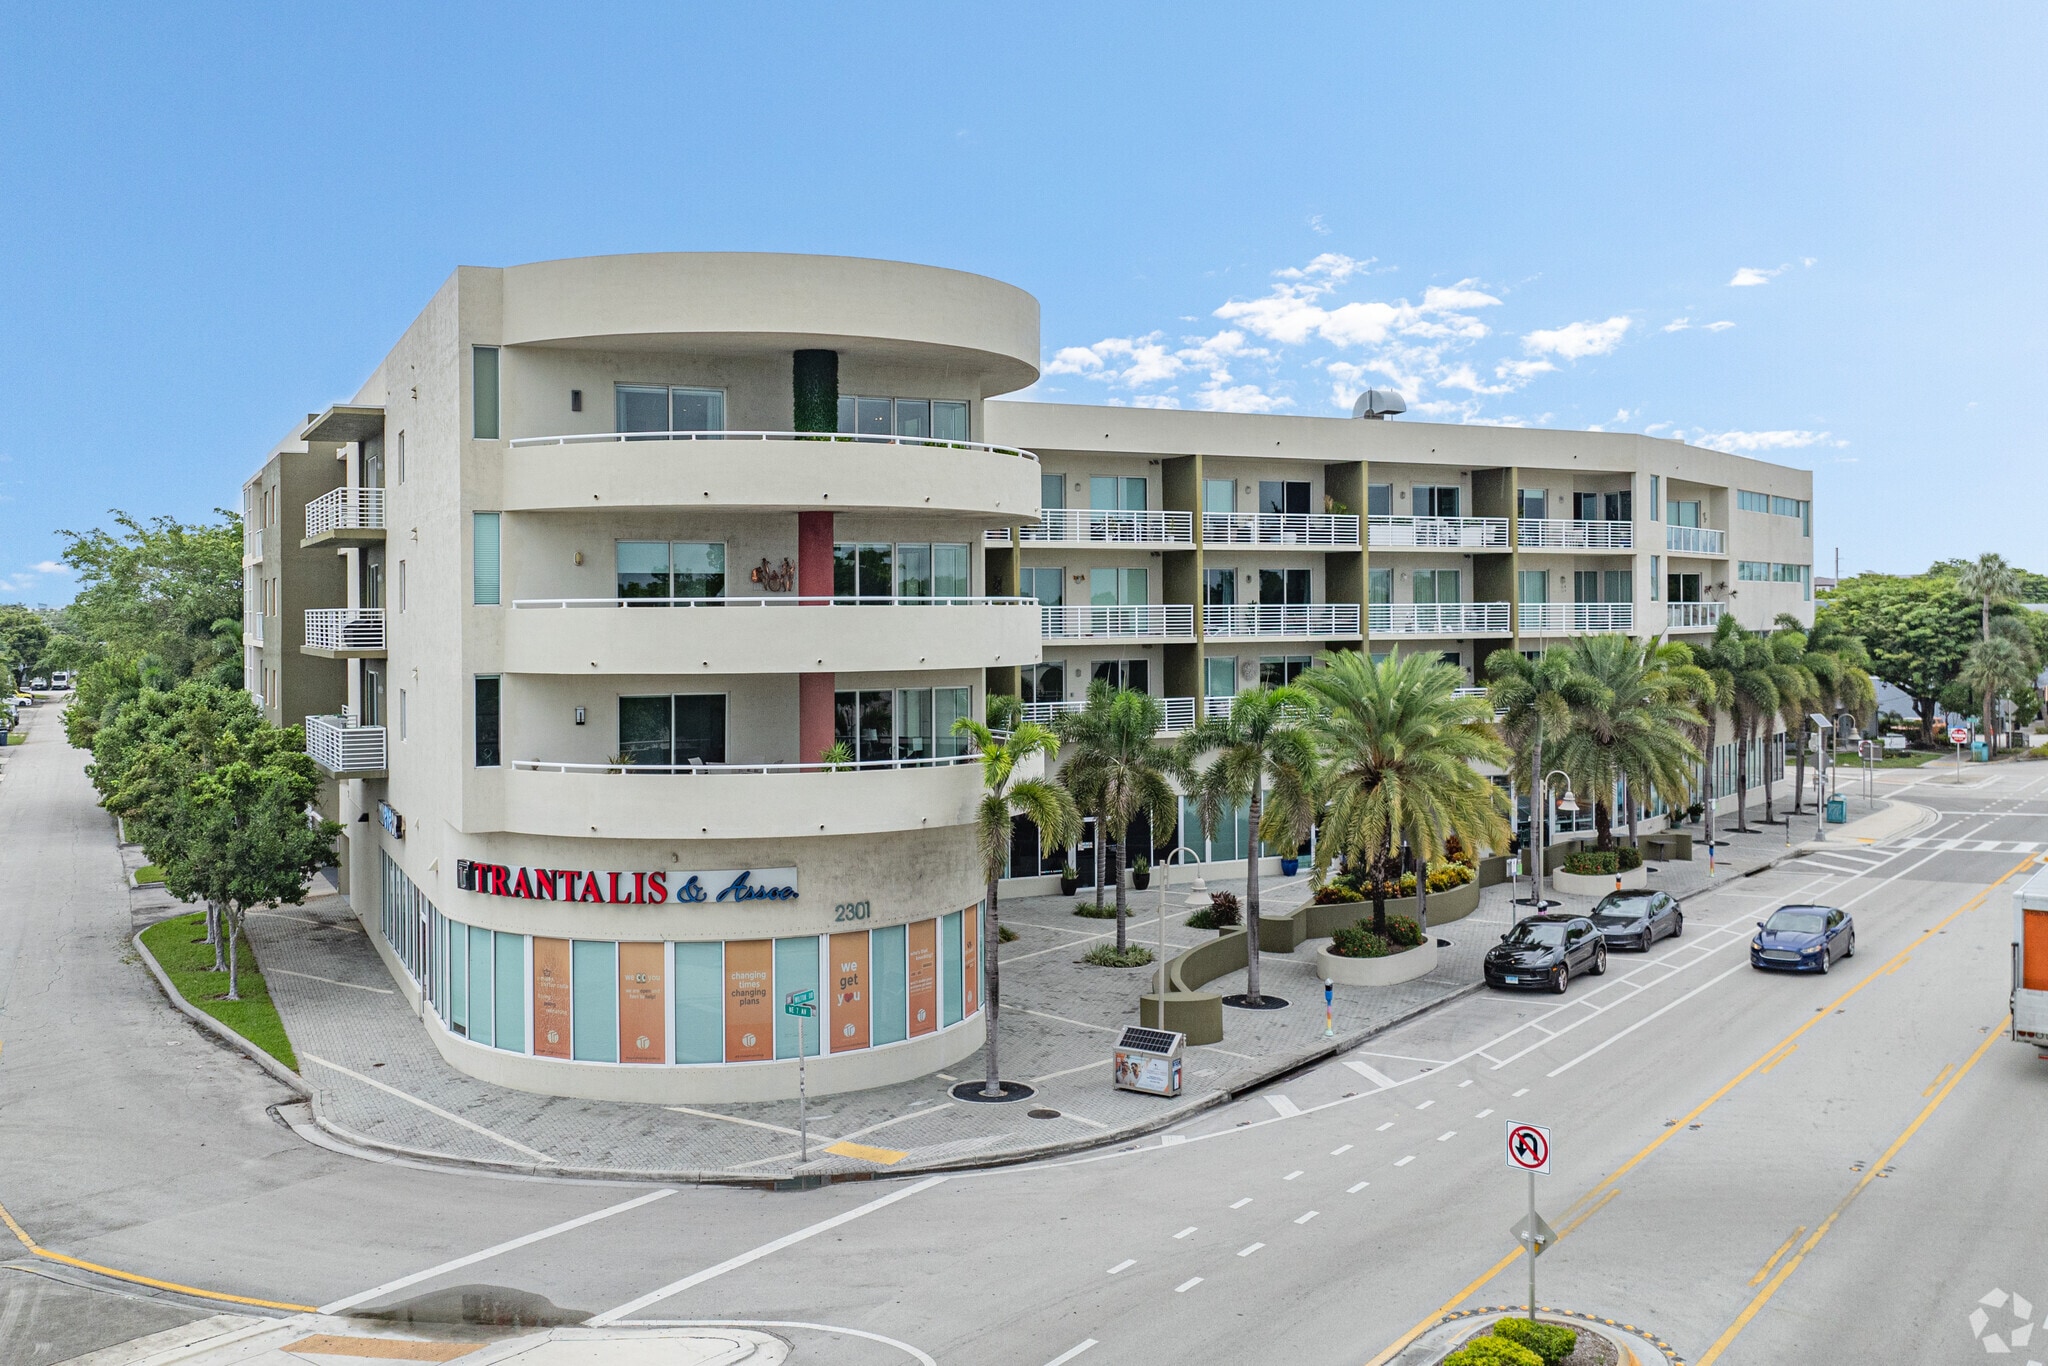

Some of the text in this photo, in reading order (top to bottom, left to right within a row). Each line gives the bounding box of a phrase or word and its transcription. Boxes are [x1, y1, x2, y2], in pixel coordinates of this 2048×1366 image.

[473, 862, 668, 905] TRANTALIS
[677, 875, 707, 903] &
[835, 901, 870, 922] 2301
[841, 962, 857, 972] we
[731, 971, 767, 981] changing
[739, 981, 760, 989] times
[840, 974, 858, 990] get
[731, 988, 767, 998] changing
[740, 998, 760, 1007] plans
[789, 1006, 794, 1014] NE
